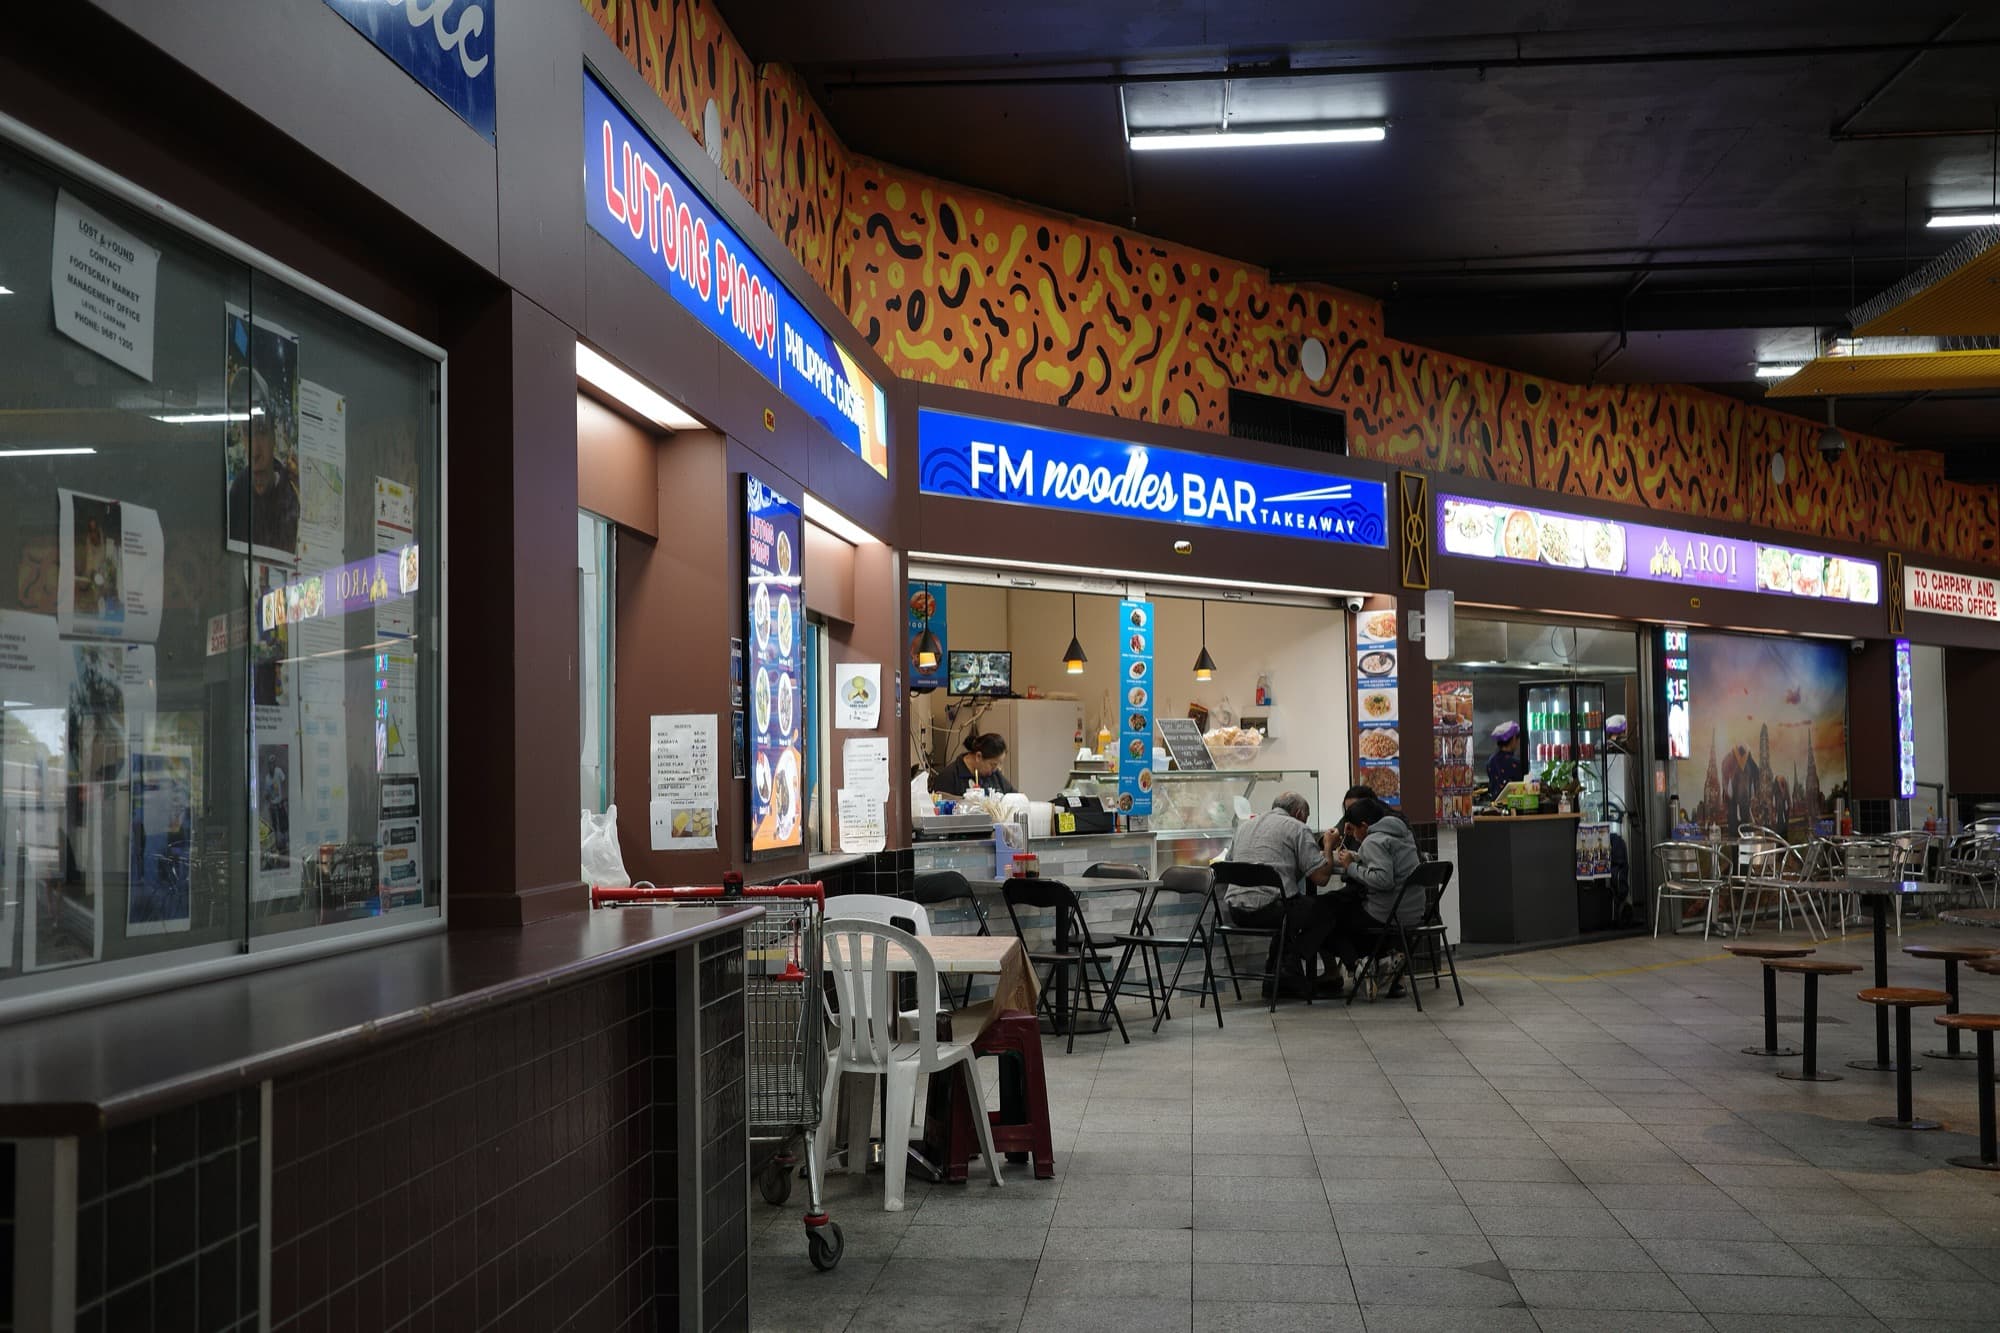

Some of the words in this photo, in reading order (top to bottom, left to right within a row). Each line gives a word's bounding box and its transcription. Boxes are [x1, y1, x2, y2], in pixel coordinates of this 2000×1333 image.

[79, 218, 98, 241] LOST
[106, 239, 135, 262] FOUND
[602, 119, 712, 302] LUTONG
[715, 237, 777, 359] PINOY
[69, 255, 111, 287] FOOTSCRAY
[111, 279, 140, 303] MARKET
[89, 247, 122, 275] CONTACT
[67, 273, 115, 308] MANAGEMENT
[116, 301, 141, 323] OFFICE
[74, 311, 100, 334] PHONE:
[784, 321, 836, 405] PHILIPPINE
[970, 441, 1034, 497] FM
[1042, 450, 1179, 513] noodles
[1182, 472, 1257, 525] BAR
[1260, 508, 1356, 536] TAKEAWAY
[1683, 540, 1738, 576] AROI
[1914, 569, 1928, 589] TO
[1931, 573, 1973, 596] CARPARK
[1977, 581, 1995, 598] AND
[1913, 589, 1964, 613] MANAGERS
[1967, 597, 1998, 617] OFFICE
[1665, 631, 1687, 652] BOAT
[1666, 677, 1688, 703] $15
